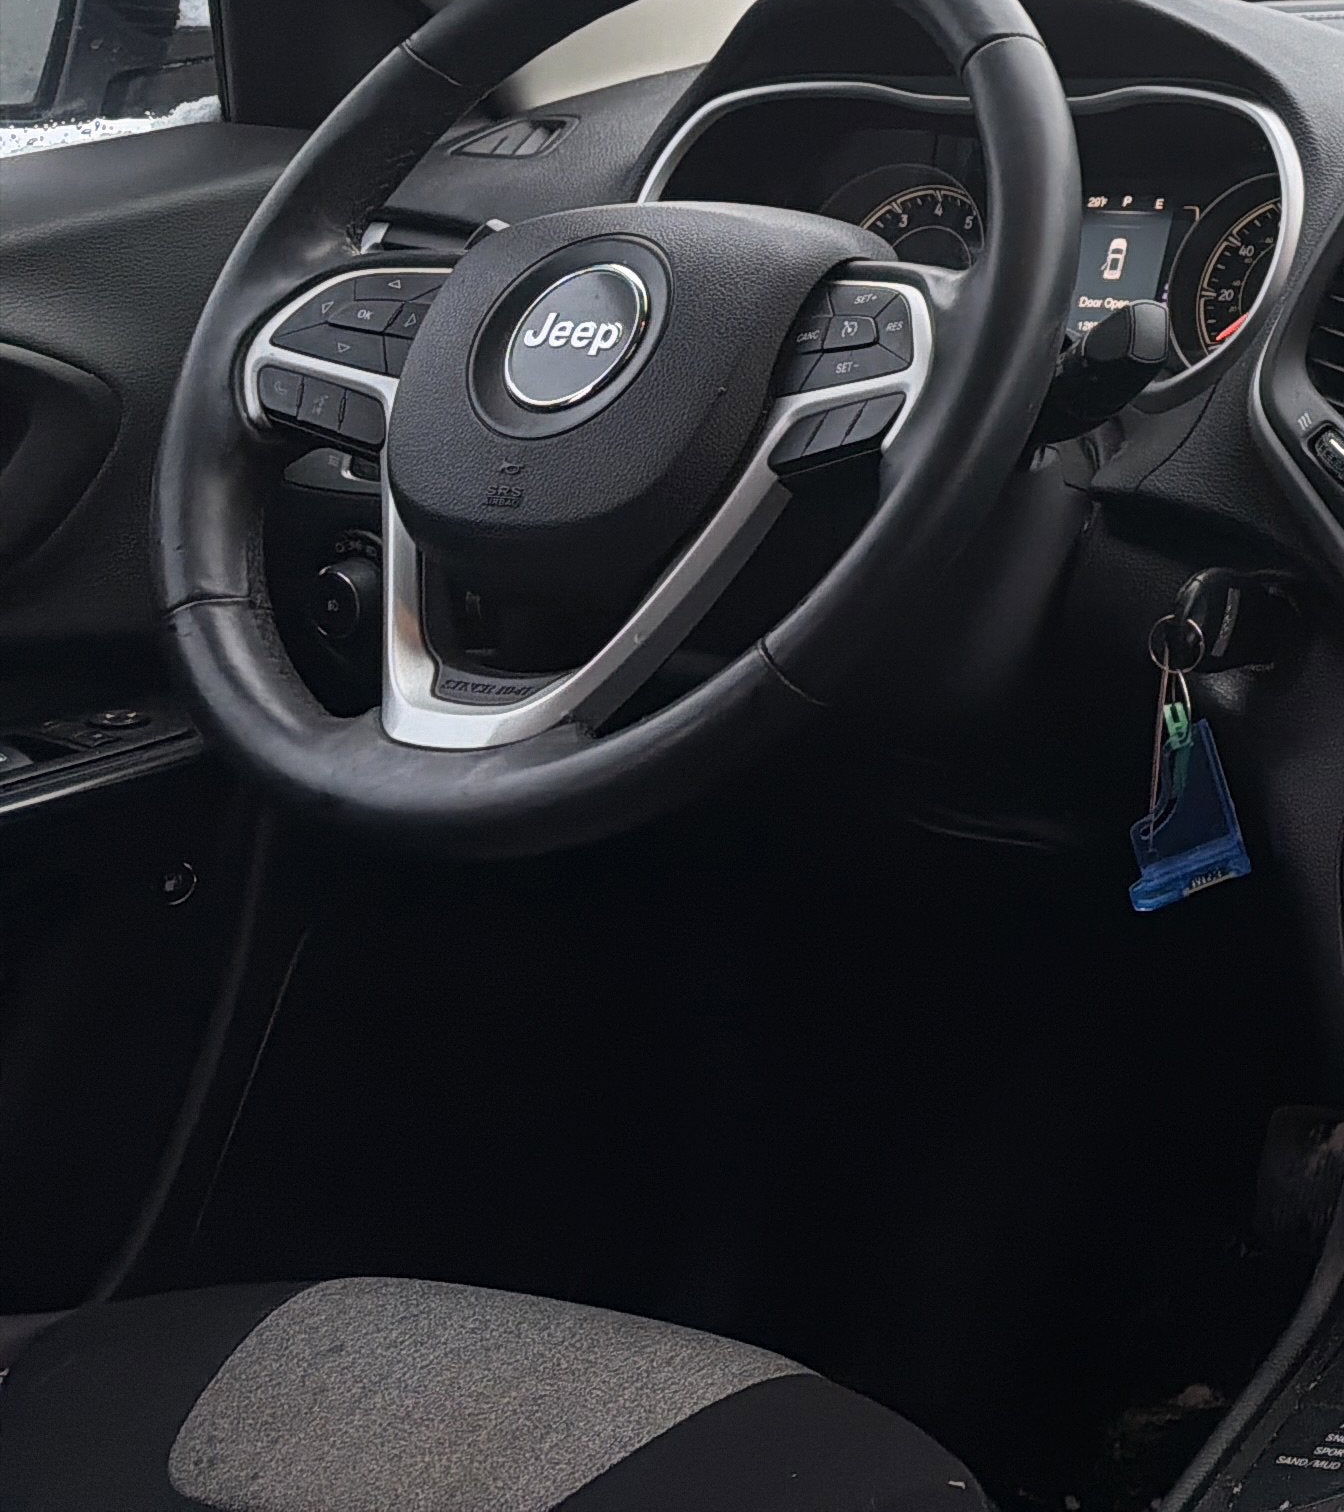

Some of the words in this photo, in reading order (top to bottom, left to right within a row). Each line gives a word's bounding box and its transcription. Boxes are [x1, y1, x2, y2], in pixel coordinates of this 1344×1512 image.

[1121, 195, 1133, 208] P
[934, 202, 944, 217] 4
[898, 214, 909, 228] 3
[964, 215, 973, 229] 5
[1238, 244, 1255, 257] 40
[853, 293, 878, 305] SET+
[1217, 288, 1234, 302] 20
[1078, 296, 1102, 308] Door
[357, 308, 374, 321] OK
[522, 311, 623, 356] Jeep
[885, 321, 904, 333] RES
[486, 486, 523, 498] SRS
[1276, 1455, 1341, 1470] SAND/MUD
